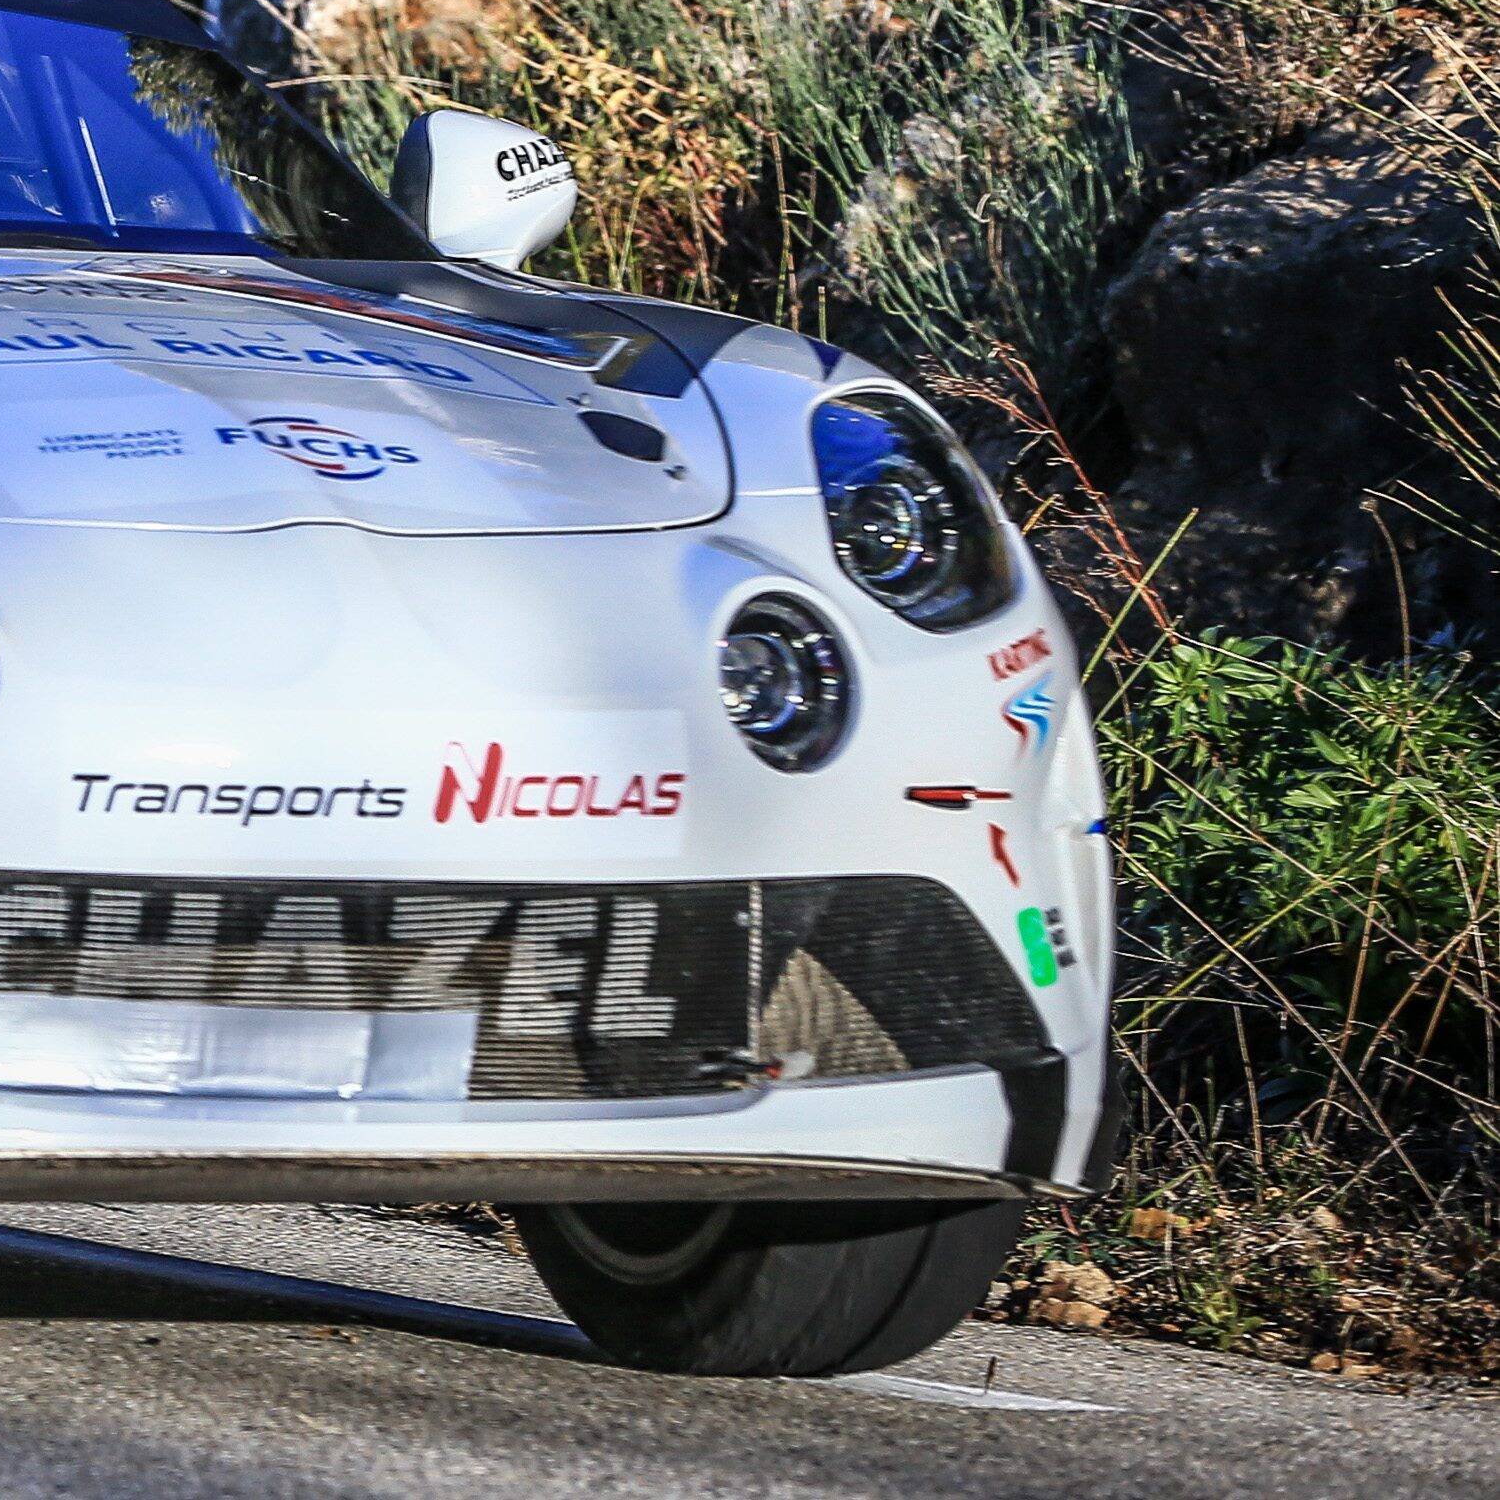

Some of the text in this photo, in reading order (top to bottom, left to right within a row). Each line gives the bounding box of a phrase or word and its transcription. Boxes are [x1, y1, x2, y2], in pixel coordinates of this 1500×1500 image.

[152, 338, 473, 382] RICARD
[214, 427, 421, 464] FUCHS
[71, 772, 408, 827] Transports
